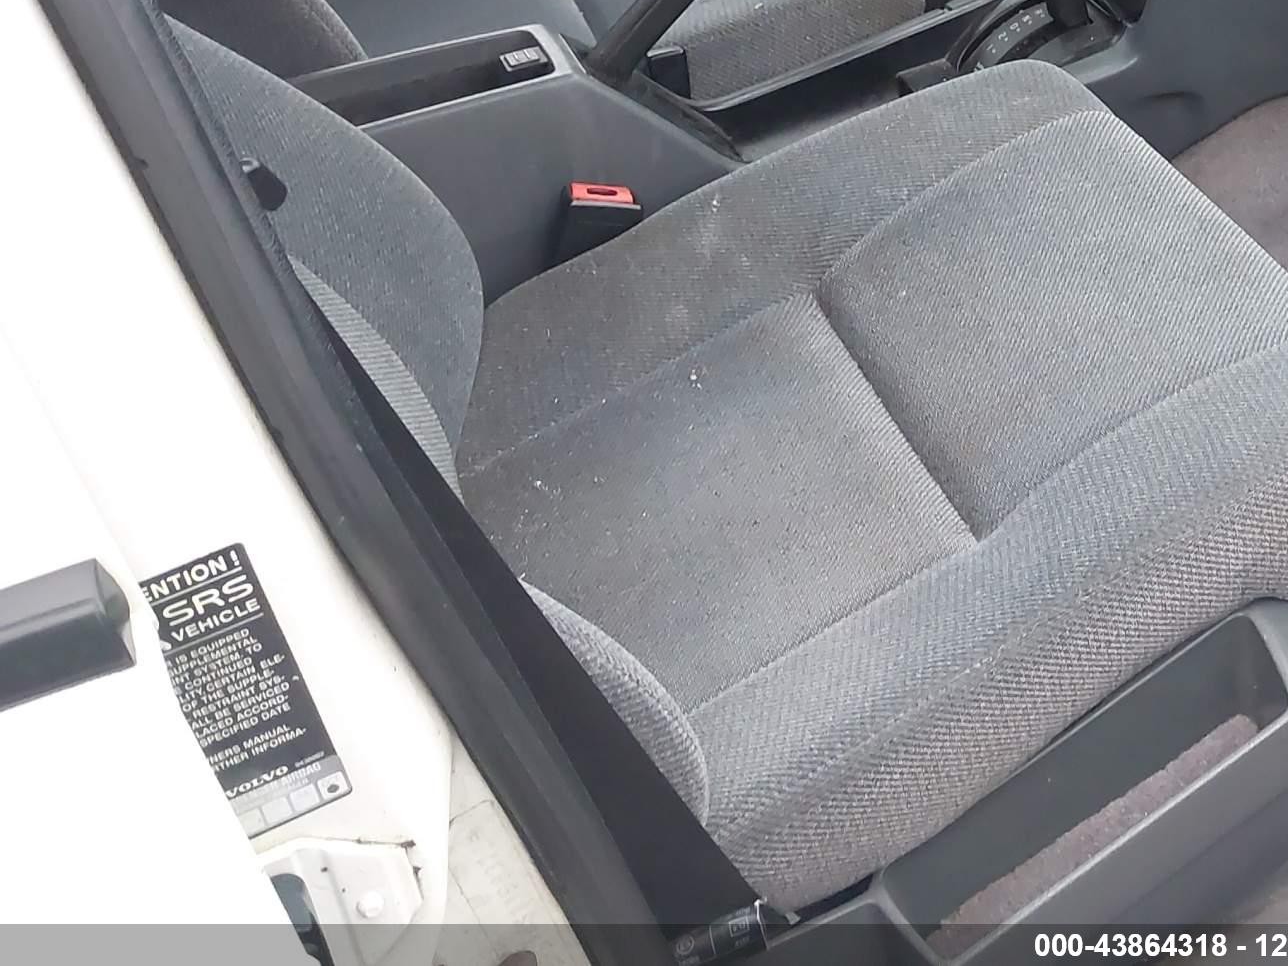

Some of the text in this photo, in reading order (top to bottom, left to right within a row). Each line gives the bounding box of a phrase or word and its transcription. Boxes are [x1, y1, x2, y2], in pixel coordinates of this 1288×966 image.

[162, 574, 254, 627] SRS
[171, 598, 261, 642] VEHICLE
[175, 628, 250, 664] IS EQUIPPED
[246, 642, 262, 655] TO
[185, 657, 252, 690] CONTINUED
[206, 665, 256, 693] CERTAIN
[182, 699, 198, 713] OF
[201, 690, 225, 705] THE
[191, 681, 290, 730] ALL BE SERVICED
[192, 685, 256, 719] RESTRAINT
[196, 716, 234, 739] LACED
[199, 702, 291, 748] SPECIFIED DATE
[243, 724, 291, 749] MANUAL
[226, 765, 289, 798] VOLVO
